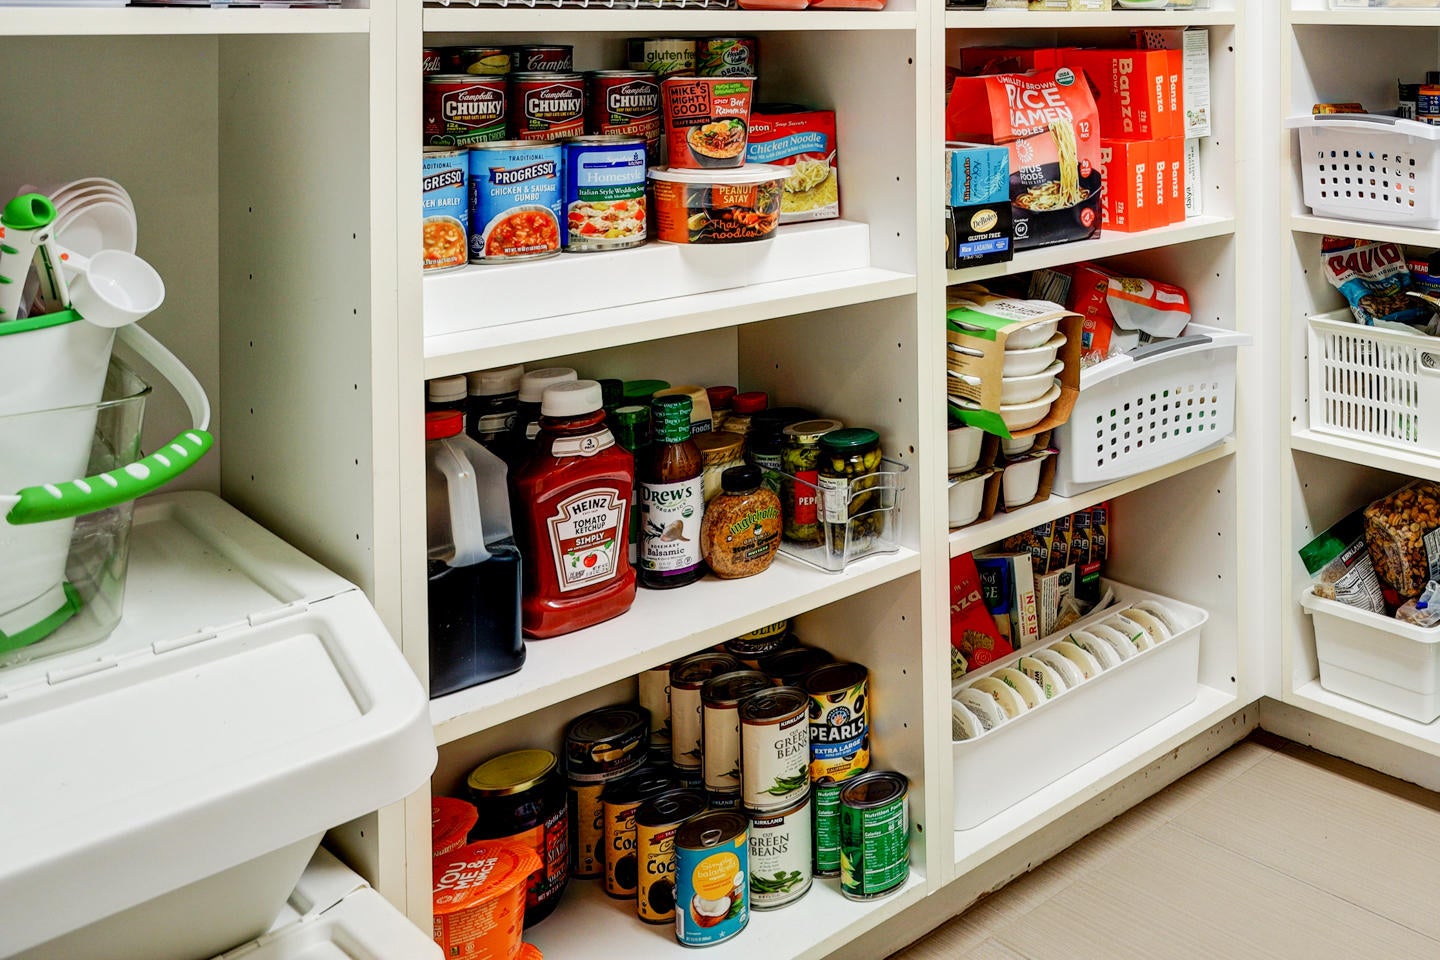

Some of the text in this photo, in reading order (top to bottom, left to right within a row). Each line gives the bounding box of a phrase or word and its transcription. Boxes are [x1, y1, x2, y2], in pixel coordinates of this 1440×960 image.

[647, 50, 681, 63] gluten
[1026, 82, 1056, 90] BROWN
[610, 93, 658, 107] CHUNKY
[670, 94, 707, 104] MIGHTY
[1119, 58, 1133, 133] Banza
[1155, 76, 1164, 112] Banza
[446, 100, 502, 117] CHUNKY
[528, 98, 581, 113] CHUNKY
[1079, 122, 1089, 132] 12
[750, 134, 821, 154] Chicken Noodle
[495, 164, 554, 184] PROGRESSO
[1172, 161, 1180, 198] Banza
[1135, 163, 1145, 208] Banza
[1156, 161, 1165, 205] Banza
[491, 187, 522, 196] CHICKEN
[514, 193, 540, 201] GUMBO
[724, 195, 748, 203] SATAY
[438, 198, 461, 208] BARLEY
[968, 231, 1001, 242] GLUTEN FREE
[1328, 244, 1402, 277] DAVID
[691, 424, 711, 434] Foods
[573, 498, 607, 514] HEINZ
[573, 514, 607, 529] TOMATO
[575, 522, 606, 535] KETCHUP
[576, 532, 604, 547] SIMPLY
[648, 547, 685, 556] Balsamic
[810, 718, 864, 741] PEARLS
[815, 739, 862, 755] EXTRA LARGE
[753, 818, 783, 827] KIRKLAND
[750, 833, 790, 848] GREEN
[751, 843, 789, 856] BEANS
[437, 862, 466, 890] YOU
